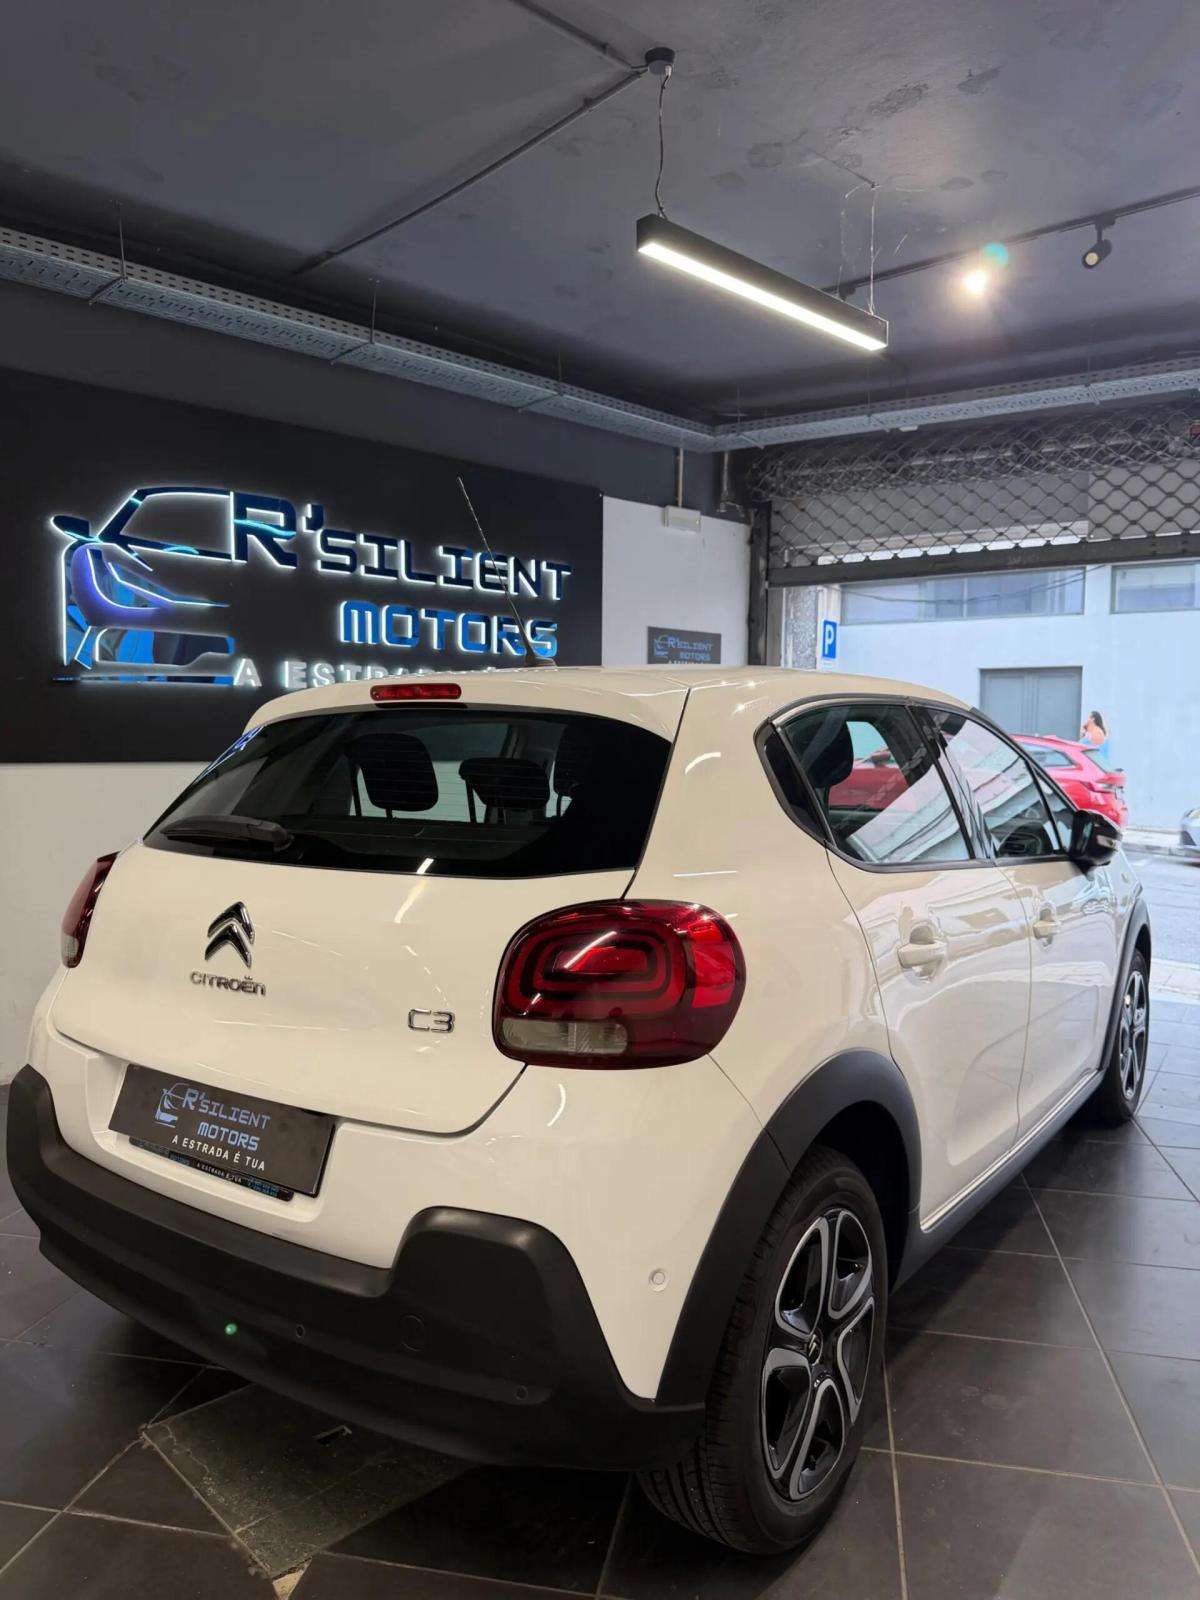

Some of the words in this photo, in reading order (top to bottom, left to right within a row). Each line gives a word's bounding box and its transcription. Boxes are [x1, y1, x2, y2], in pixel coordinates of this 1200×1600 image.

[230, 491, 571, 601] R'SILIENT
[340, 600, 558, 658] MOTORS
[825, 624, 834, 655] P
[234, 657, 262, 688] A
[408, 1008, 455, 1033] C3
[182, 1088, 271, 1130] R'SILIENT
[172, 1135, 178, 1144] A
[182, 1138, 229, 1160] ESTRADA
[233, 1151, 241, 1163] É
[245, 1156, 265, 1171] TUA
[197, 1122, 260, 1151] MOTORS
